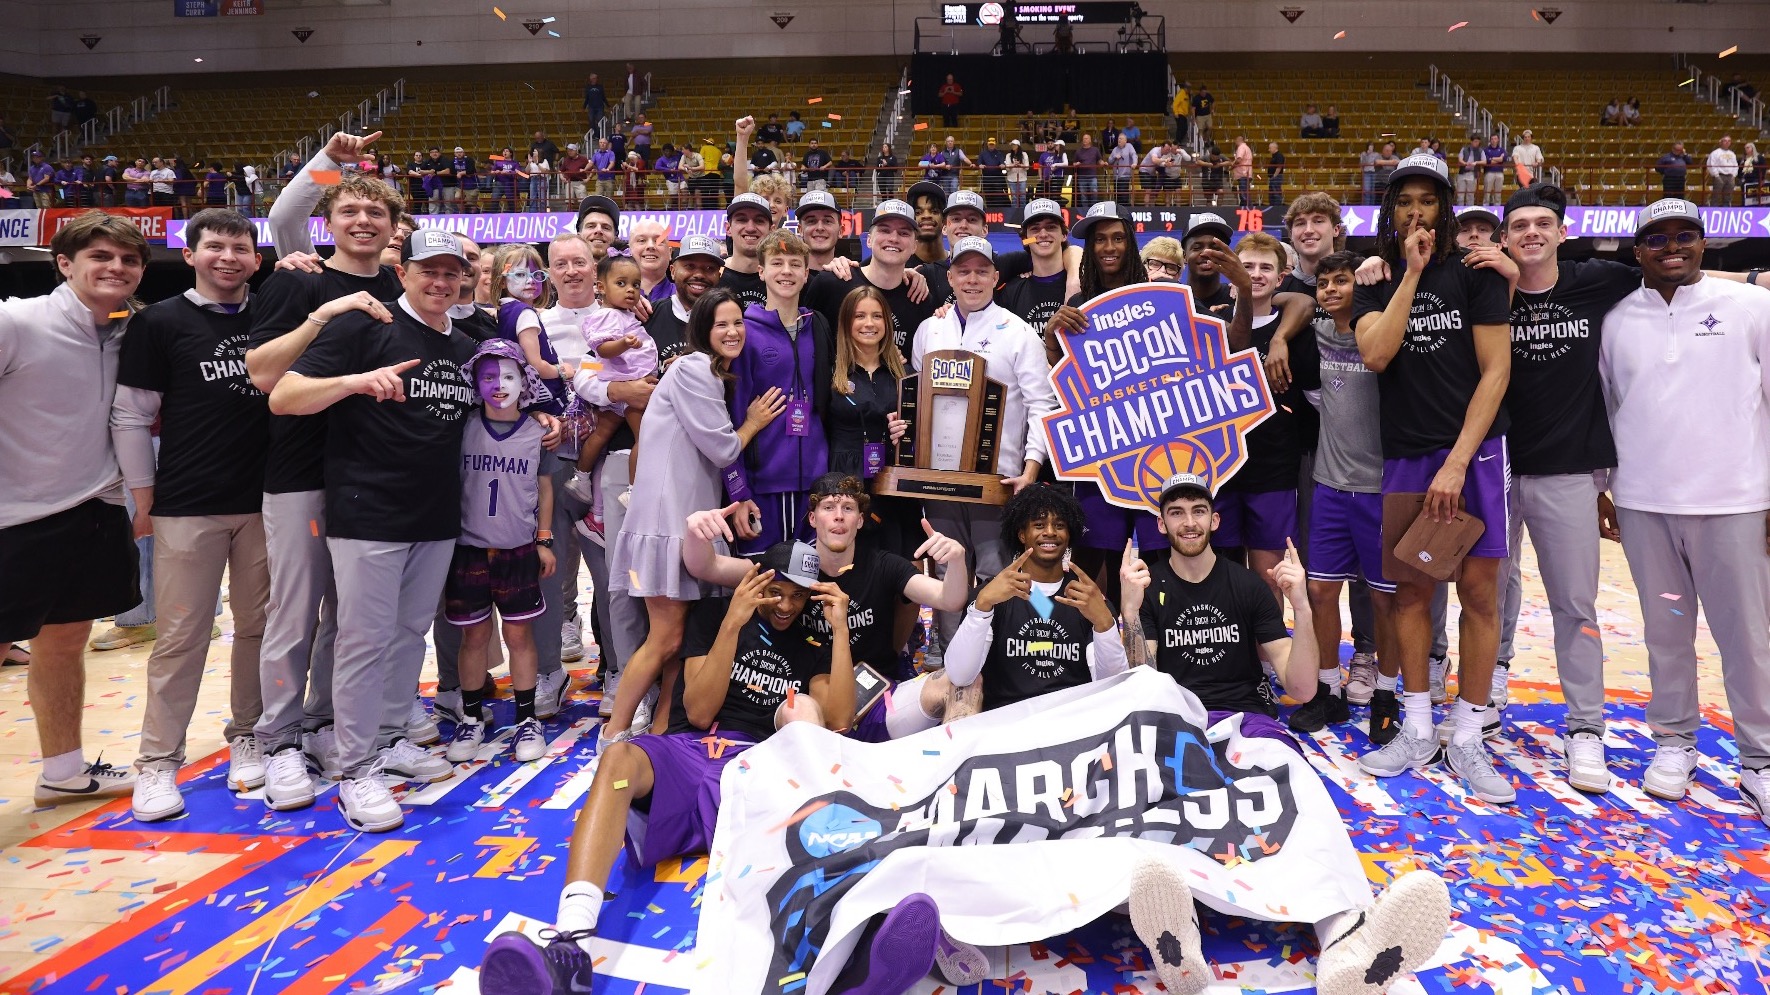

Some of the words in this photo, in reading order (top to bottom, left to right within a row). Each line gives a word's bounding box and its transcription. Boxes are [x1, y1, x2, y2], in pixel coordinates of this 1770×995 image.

[227, 7, 257, 15] JENNINGS
[1019, 5, 1053, 13] SMOKING
[1054, 5, 1077, 13] EVENT
[1409, 160, 1435, 168] CHAMPS
[1653, 204, 1684, 215] CHAMPS
[134, 216, 166, 237] ERE.
[1236, 209, 1263, 232] 76
[1581, 210, 1638, 234] FURM
[1092, 300, 1156, 332] ingles
[1430, 335, 1447, 351] HERE
[1513, 346, 1529, 359] IT'S
[1550, 343, 1572, 359] HERE
[422, 360, 438, 377] MEN'S
[1089, 364, 1205, 407] BASKETBALL
[425, 404, 441, 417] IT'S
[441, 413, 454, 421] ALL
[1056, 363, 1260, 464] CHAMPIONS
[463, 454, 529, 475] FURMAN
[1172, 476, 1195, 485] CHAMPS
[487, 478, 499, 518] 1
[1175, 608, 1192, 627] MEN'S
[1191, 603, 1228, 623] BASKETBALL
[1018, 619, 1034, 637] MEN'S
[1165, 624, 1240, 648] CHAMPIONS
[762, 649, 793, 677] BASKETBALL
[1181, 651, 1195, 663] IT'S
[1196, 658, 1210, 666] ALL
[1211, 648, 1227, 664] HERE
[730, 661, 802, 696] HAMPIONS
[1021, 661, 1036, 676] IT'S
[1037, 671, 1051, 679] ALL
[747, 694, 760, 704] ALL
[762, 696, 780, 706] HERE
